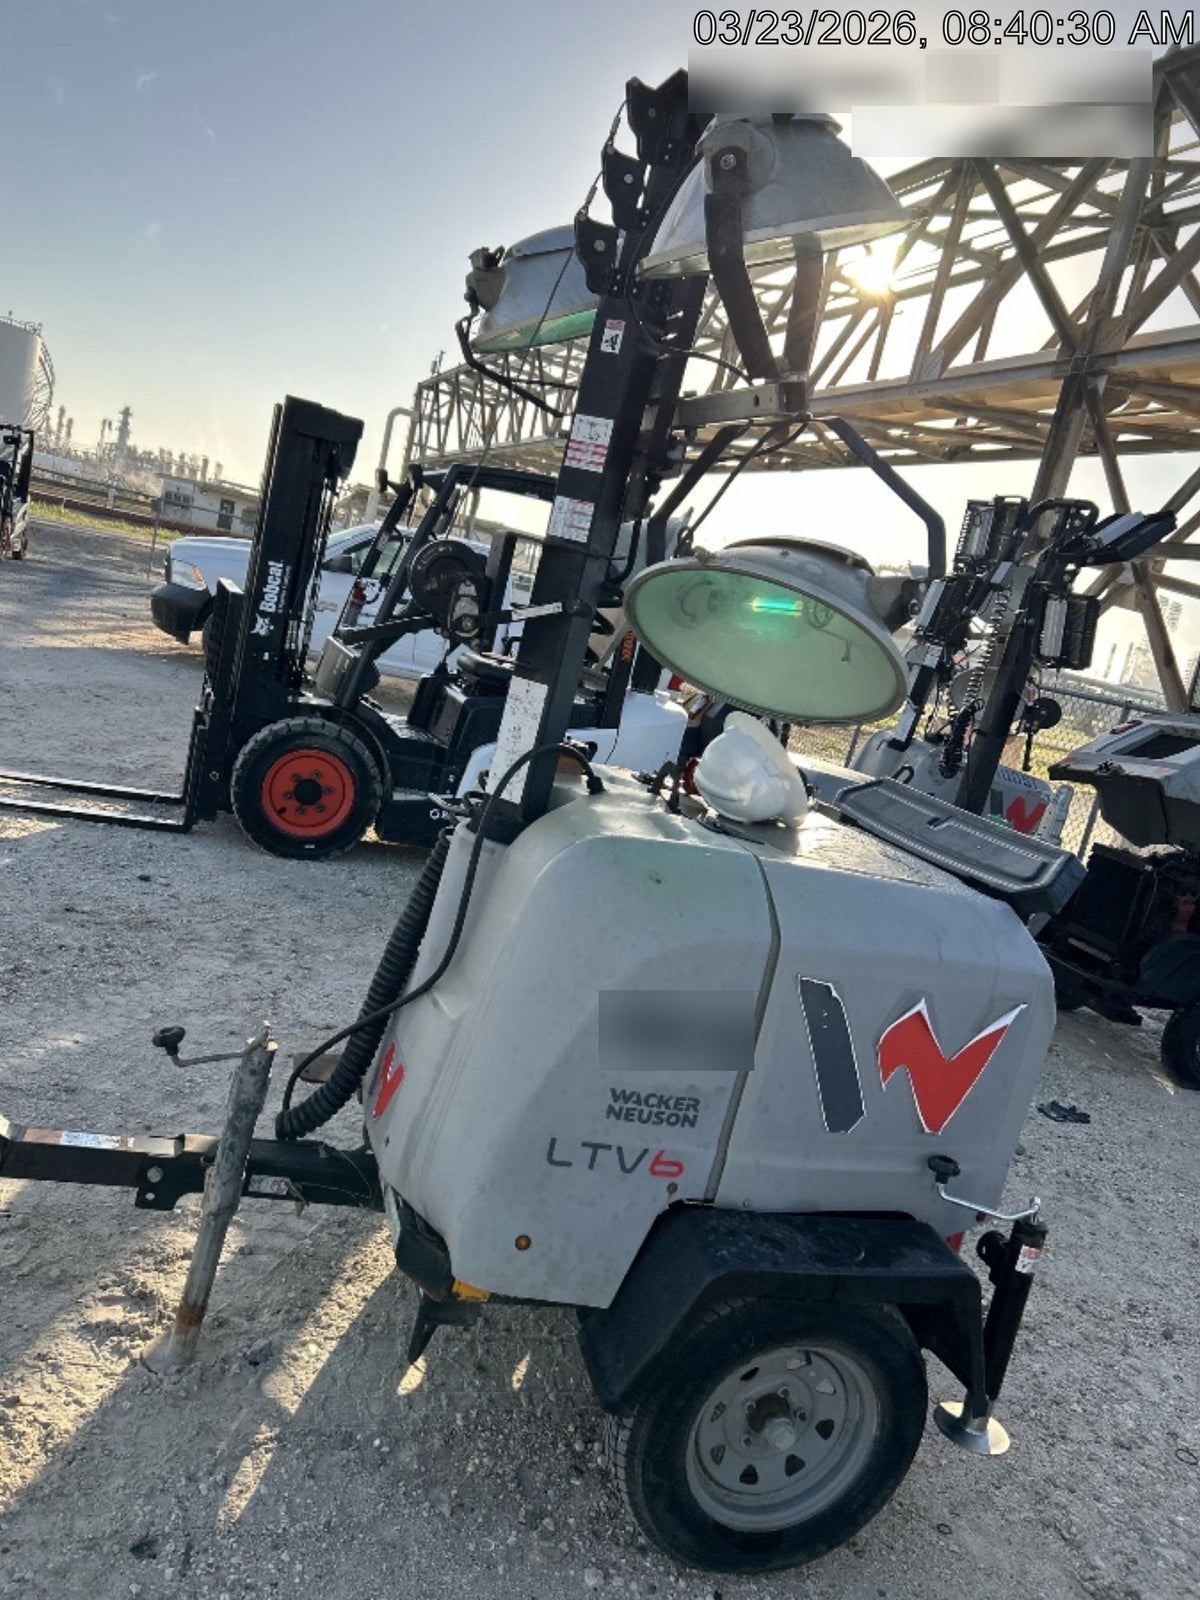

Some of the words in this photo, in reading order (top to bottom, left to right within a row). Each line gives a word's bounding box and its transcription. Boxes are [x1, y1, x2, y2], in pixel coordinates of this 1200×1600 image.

[259, 561, 283, 612] Bobcat
[605, 1103, 698, 1128] NEUSON
[610, 1087, 701, 1113] WACKER
[547, 1137, 684, 1178] LTV6
